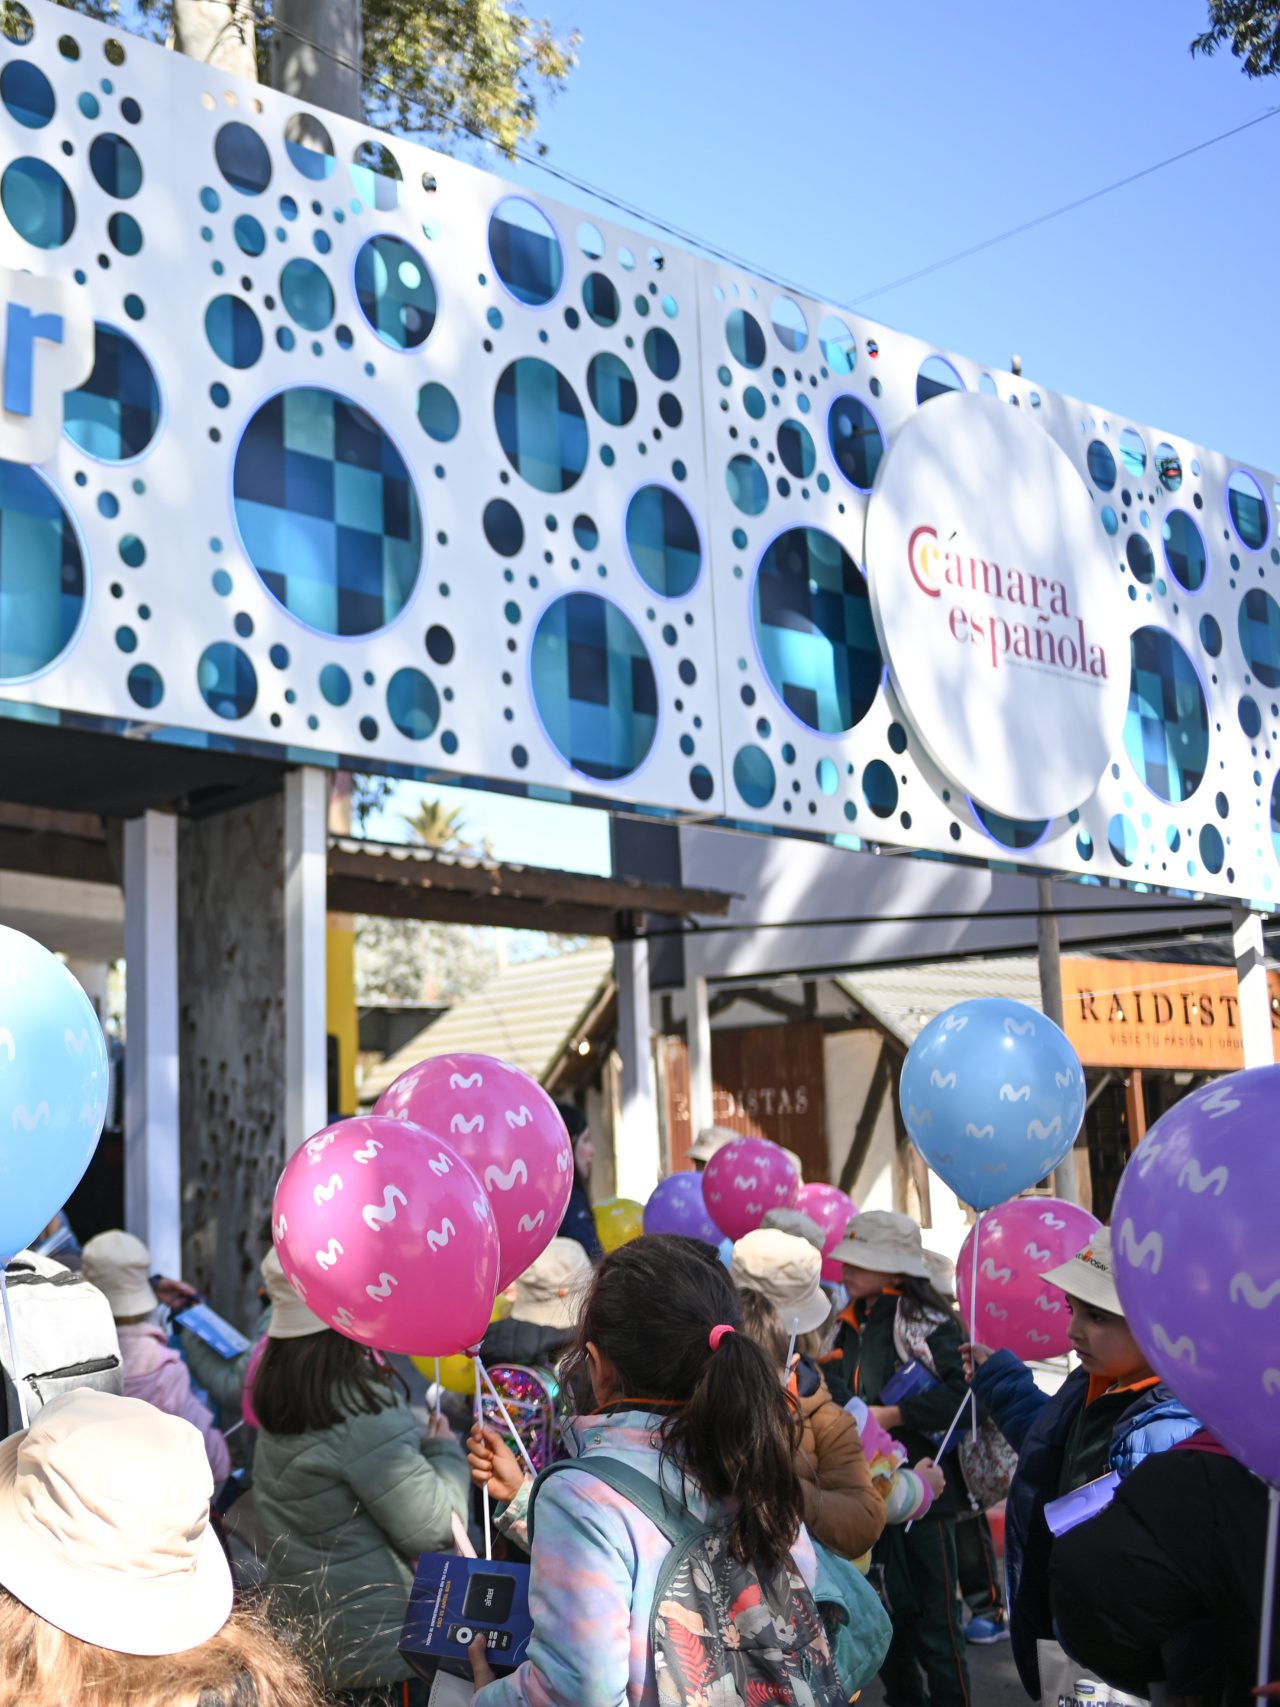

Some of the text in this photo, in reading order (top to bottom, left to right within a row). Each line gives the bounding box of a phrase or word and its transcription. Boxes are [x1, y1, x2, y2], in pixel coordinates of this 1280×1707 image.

[949, 604, 1109, 681] española
[1077, 988, 1280, 1032] RAIDISTS
[484, 1588, 495, 1607] antel
